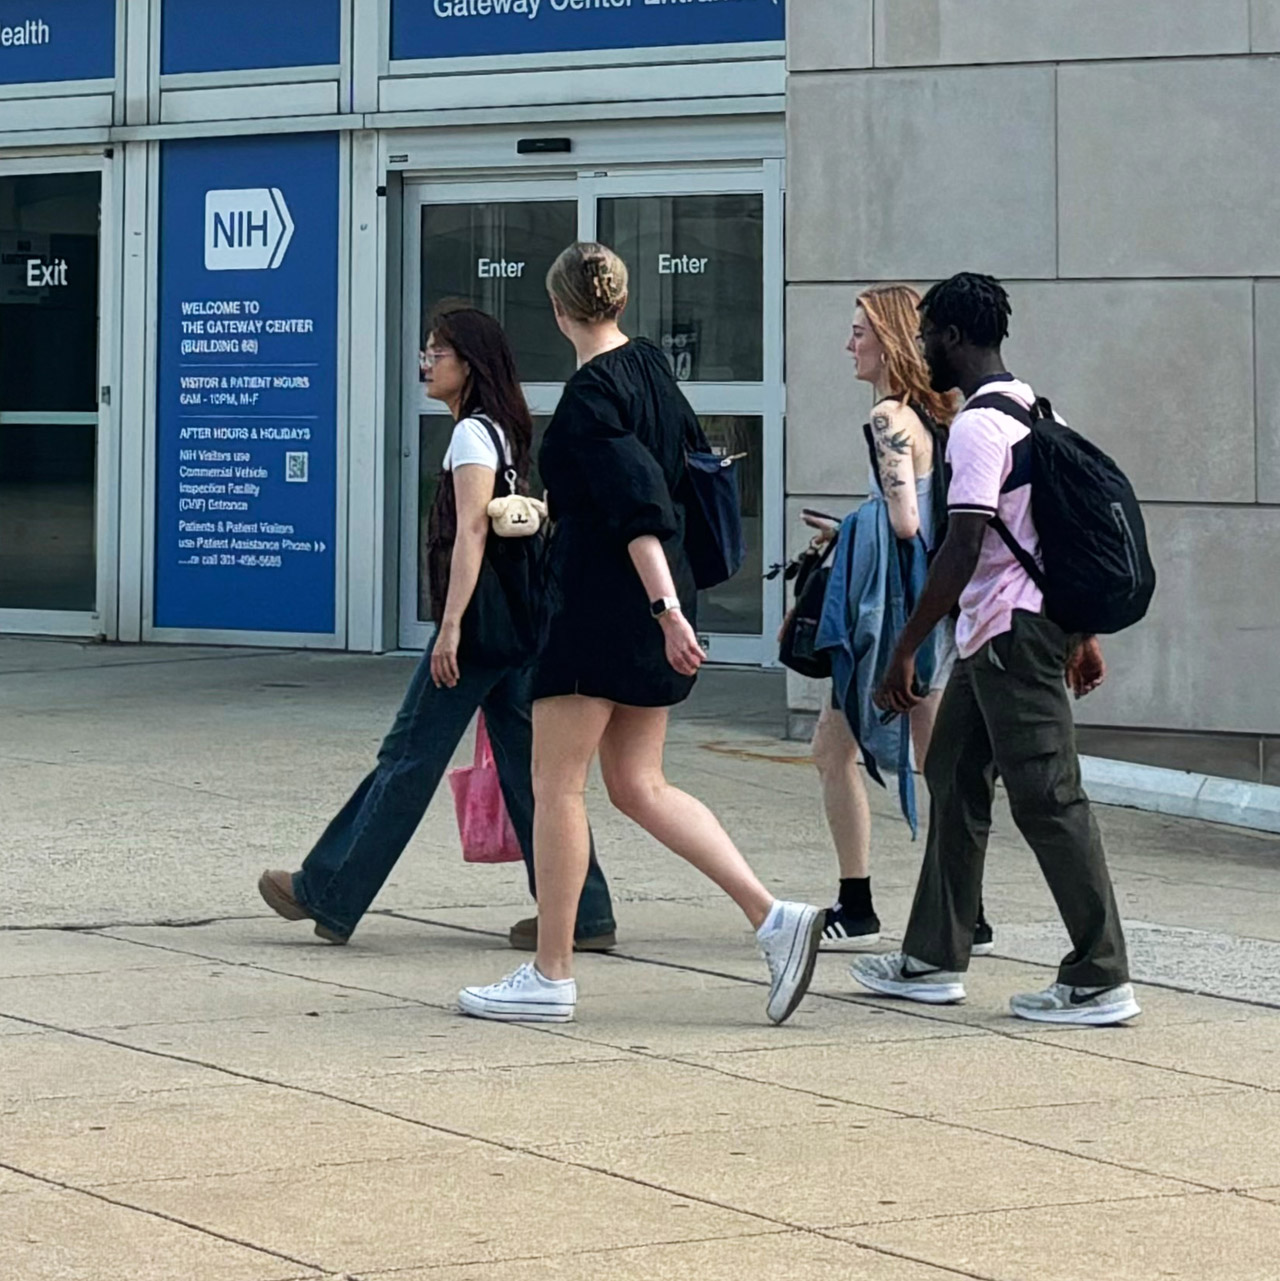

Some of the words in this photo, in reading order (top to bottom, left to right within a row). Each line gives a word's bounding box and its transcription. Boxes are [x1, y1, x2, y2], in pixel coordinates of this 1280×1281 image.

[213, 210, 268, 248] NIH
[478, 258, 525, 278] Enter
[658, 253, 708, 274] Enter
[27, 258, 68, 287] Exit
[181, 301, 240, 315] WELCOME
[243, 301, 260, 314] TO
[181, 320, 204, 334] THE
[206, 319, 263, 334] GATEWAY
[265, 319, 314, 334] CENTER
[181, 339, 239, 355] (BUILDING
[180, 377, 219, 389] VISITOR
[220, 377, 228, 388] &
[230, 376, 272, 389] PATIENT
[273, 376, 310, 388] HOURS
[180, 428, 212, 440] AFTER
[214, 428, 249, 440] HOURS
[250, 428, 258, 440] &
[260, 428, 311, 440] HOLIDAYS
[233, 452, 250, 462] use
[179, 466, 233, 478] Commercial
[235, 466, 268, 478] Vehicle
[179, 521, 215, 532] Patients
[226, 522, 258, 533] Patient
[178, 539, 195, 548] use
[197, 537, 229, 549] Patient
[231, 539, 280, 550] Assistance
